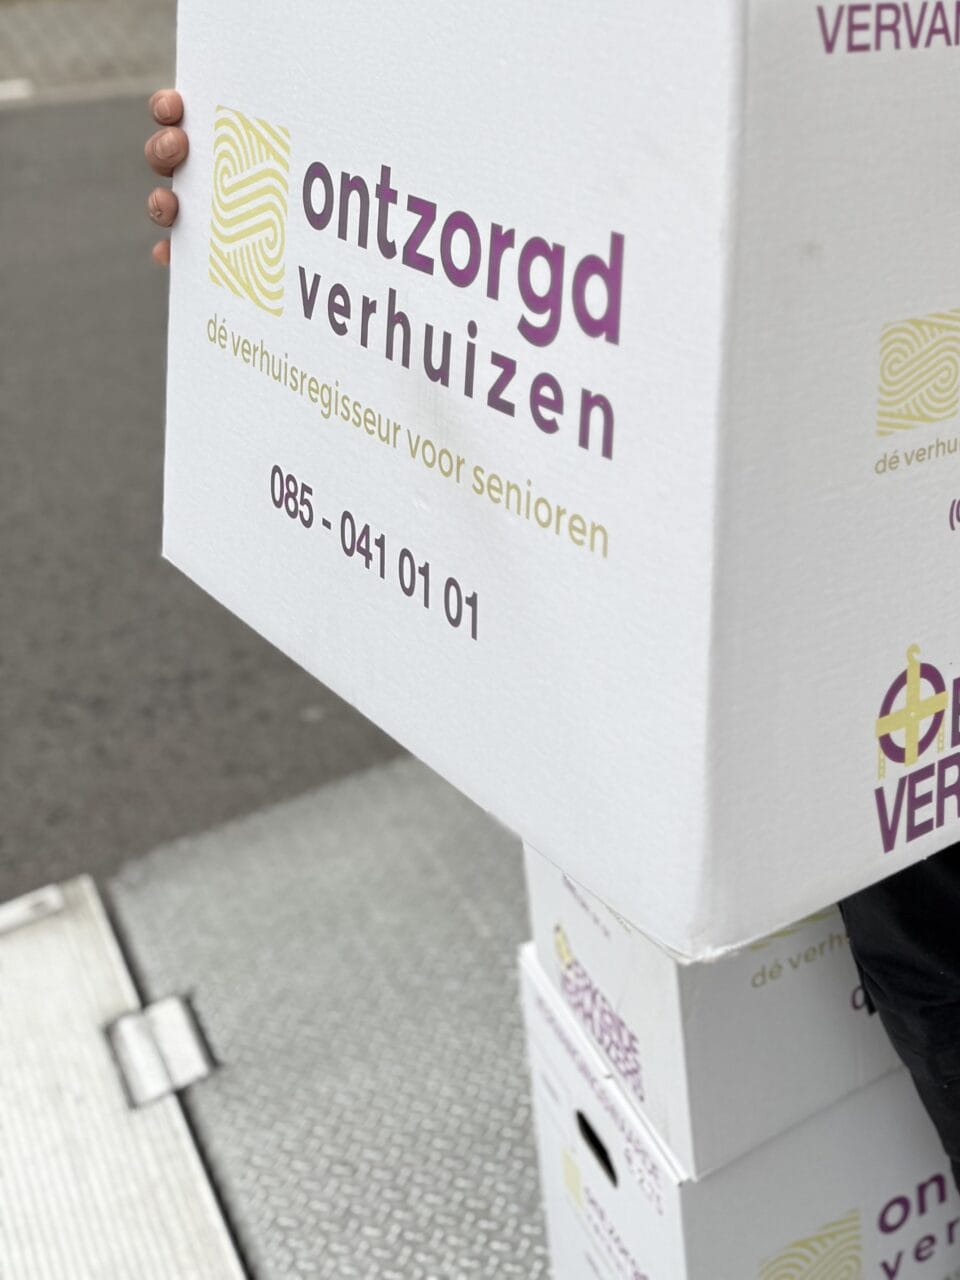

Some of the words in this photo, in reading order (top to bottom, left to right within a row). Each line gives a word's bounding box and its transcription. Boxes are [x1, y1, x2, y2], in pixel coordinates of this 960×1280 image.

[302, 160, 625, 347] ontzorgd
[206, 313, 228, 350] dé
[231, 330, 402, 449] verhuisregisseur
[406, 427, 466, 484] voor
[471, 462, 609, 559] senioren
[298, 265, 614, 461] verhuizen
[270, 464, 314, 530] 085
[322, 516, 332, 530] -
[340, 509, 386, 580] 041
[398, 547, 431, 610] 01
[444, 575, 480, 642] 01
[874, 451, 899, 475] dé
